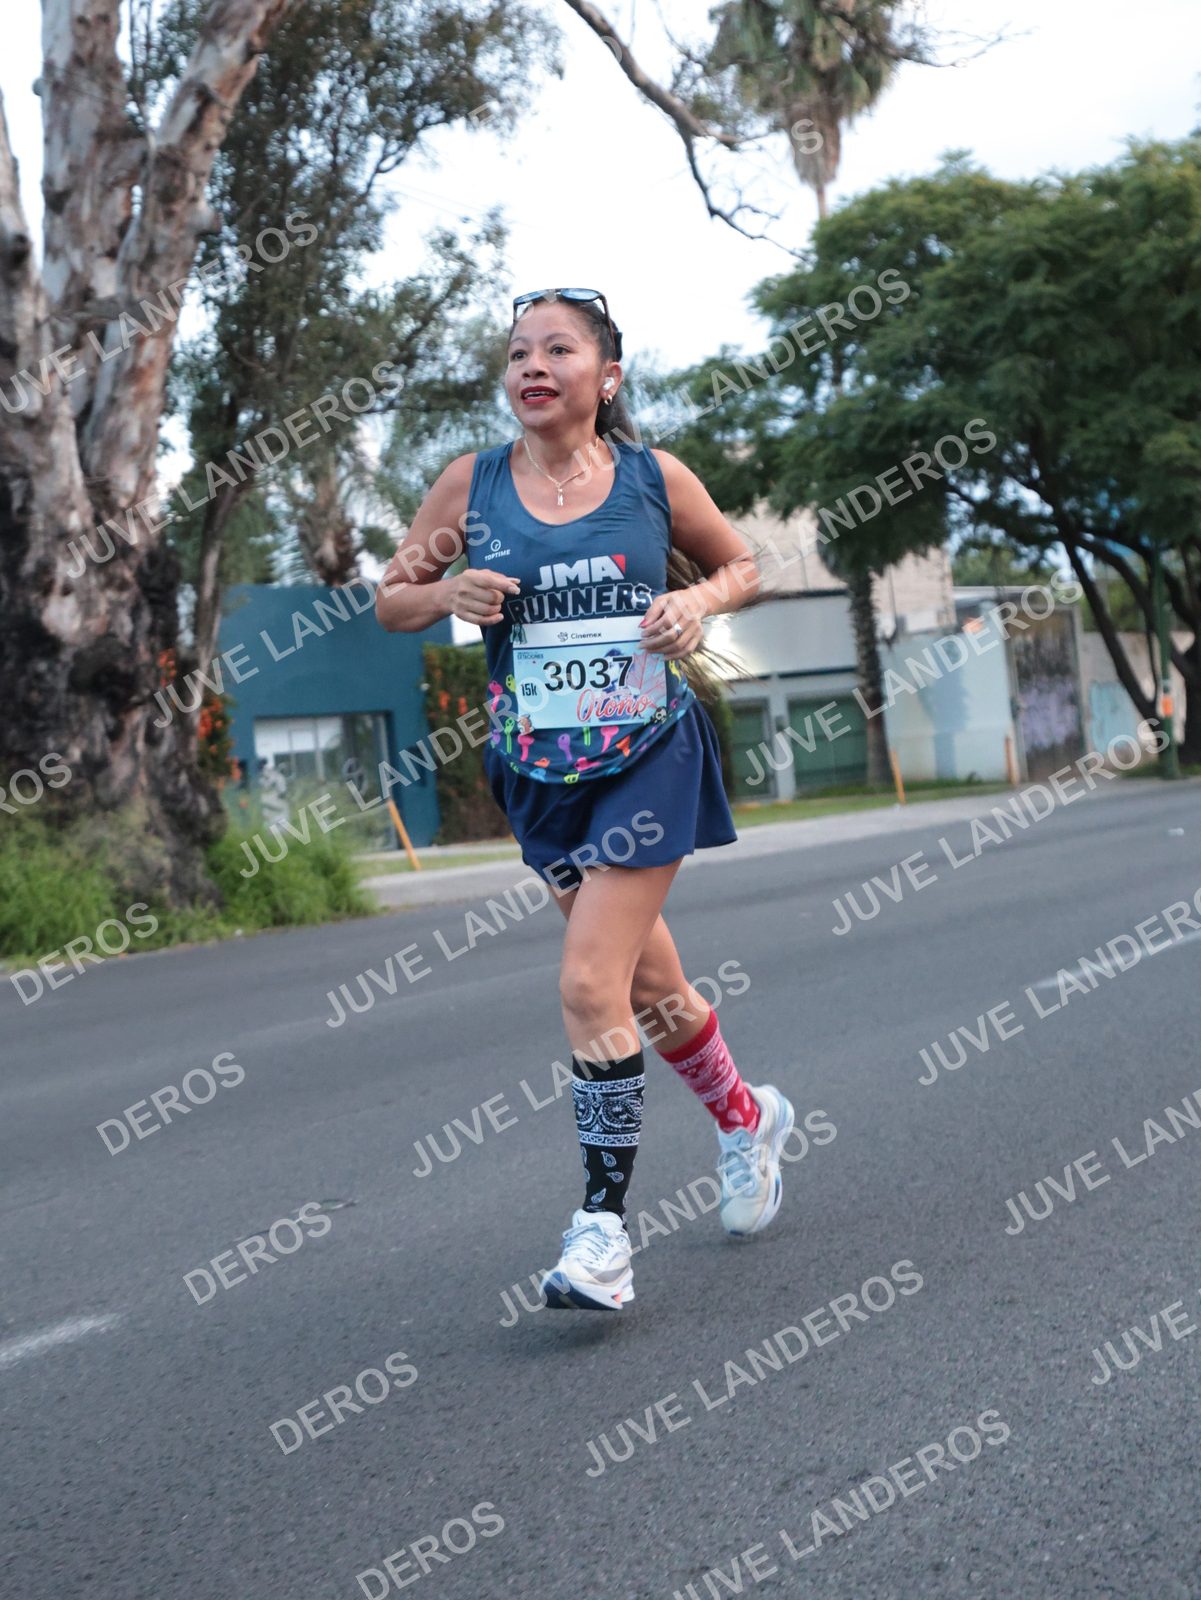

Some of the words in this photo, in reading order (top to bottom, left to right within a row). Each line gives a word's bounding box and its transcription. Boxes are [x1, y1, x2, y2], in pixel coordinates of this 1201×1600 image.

[484, 549, 511, 562] TOPTIME
[533, 555, 625, 591] JMA
[506, 582, 653, 624] RUNNERS
[571, 632, 602, 640] Cinemex
[542, 656, 633, 692] 3037
